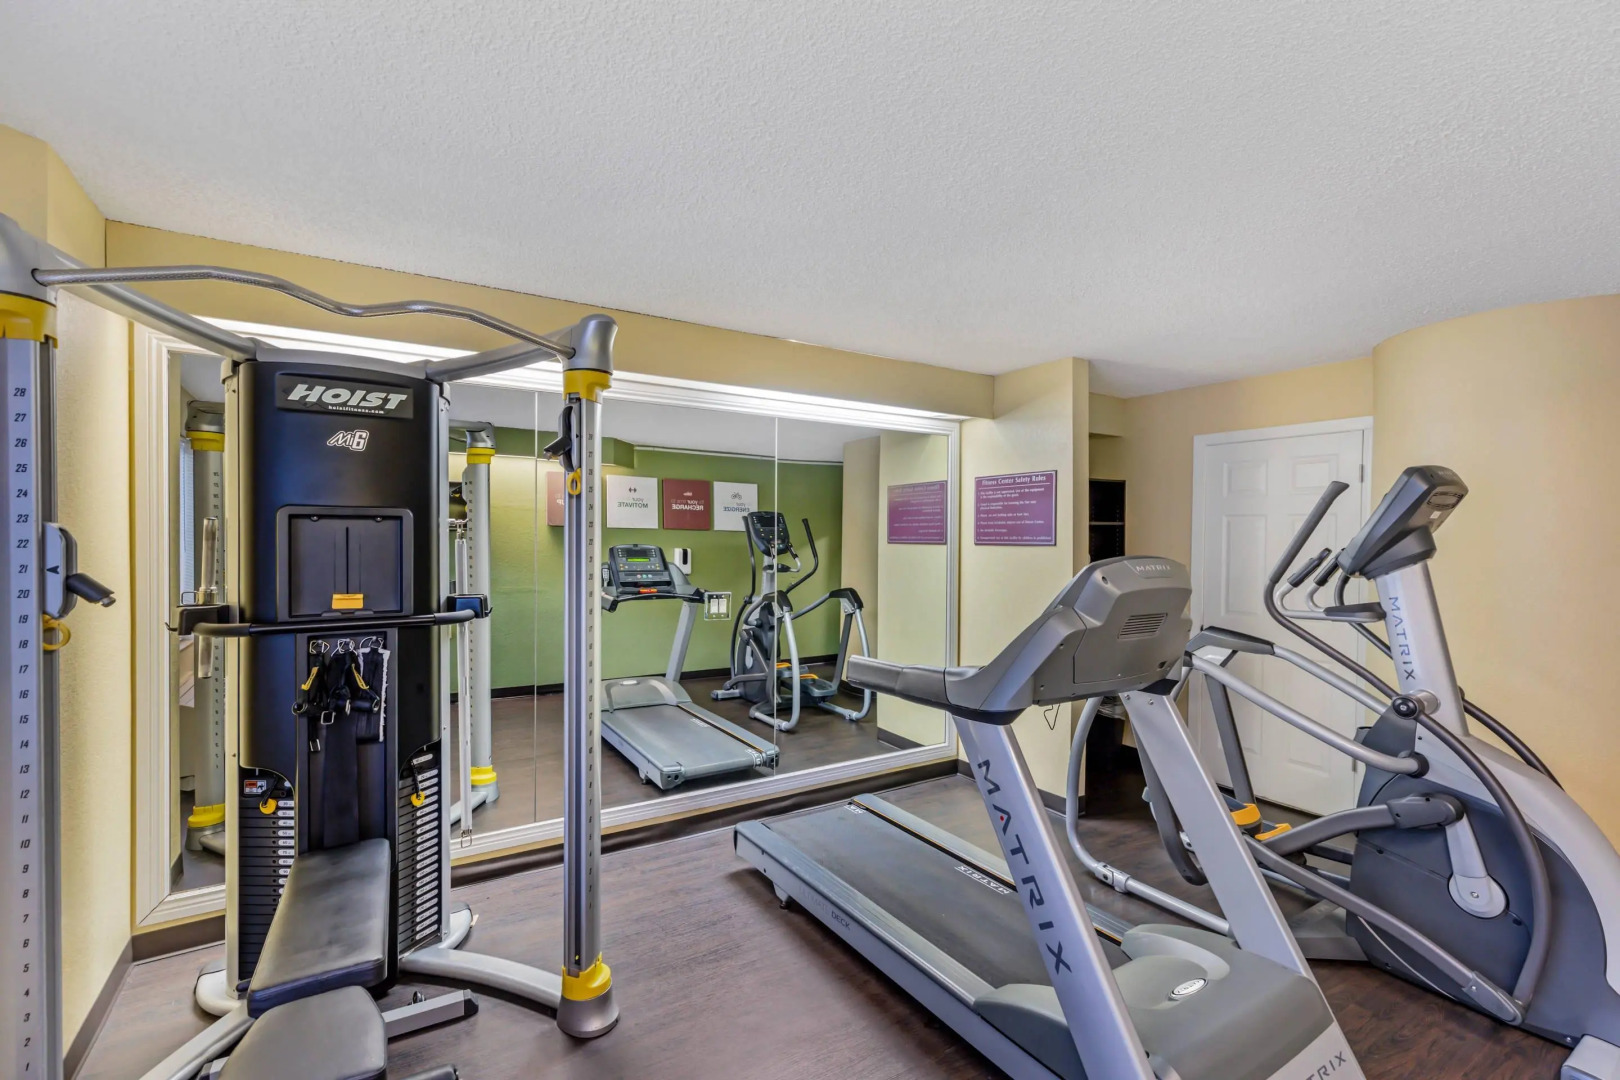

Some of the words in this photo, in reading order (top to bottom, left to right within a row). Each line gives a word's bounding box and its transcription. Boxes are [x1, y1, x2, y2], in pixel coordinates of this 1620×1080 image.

[14, 387, 27, 398] 28
[287, 383, 408, 410] HOIST
[15, 412, 27, 423] 27
[15, 437, 28, 448] 26
[15, 463, 28, 473] 25
[16, 488, 28, 498] 24
[16, 513, 30, 524] 23
[17, 538, 30, 549] 22
[19, 564, 29, 574] 21
[1136, 564, 1171, 572] MATRIX
[17, 589, 31, 599] 20
[19, 614, 29, 624] 19
[1388, 596, 1416, 680] MATRIX
[19, 639, 29, 649] 18
[19, 664, 29, 674] 17
[19, 689, 30, 699] 16
[20, 714, 29, 724] 15
[20, 739, 29, 749] 14
[20, 764, 30, 774] 13
[20, 789, 30, 799] 12
[21, 814, 29, 824] 11
[21, 838, 31, 849] 10
[22, 863, 30, 874] 9
[977, 759, 1073, 975] MATRIX
[958, 865, 1010, 894] MATRIX
[22, 888, 30, 899] 8
[22, 913, 30, 923] 7
[22, 938, 30, 949] 6
[22, 963, 30, 973] 5
[23, 988, 30, 997] 4
[23, 1012, 31, 1023] 3
[23, 1037, 31, 1048] 2
[25, 1062, 30, 1072] 1
